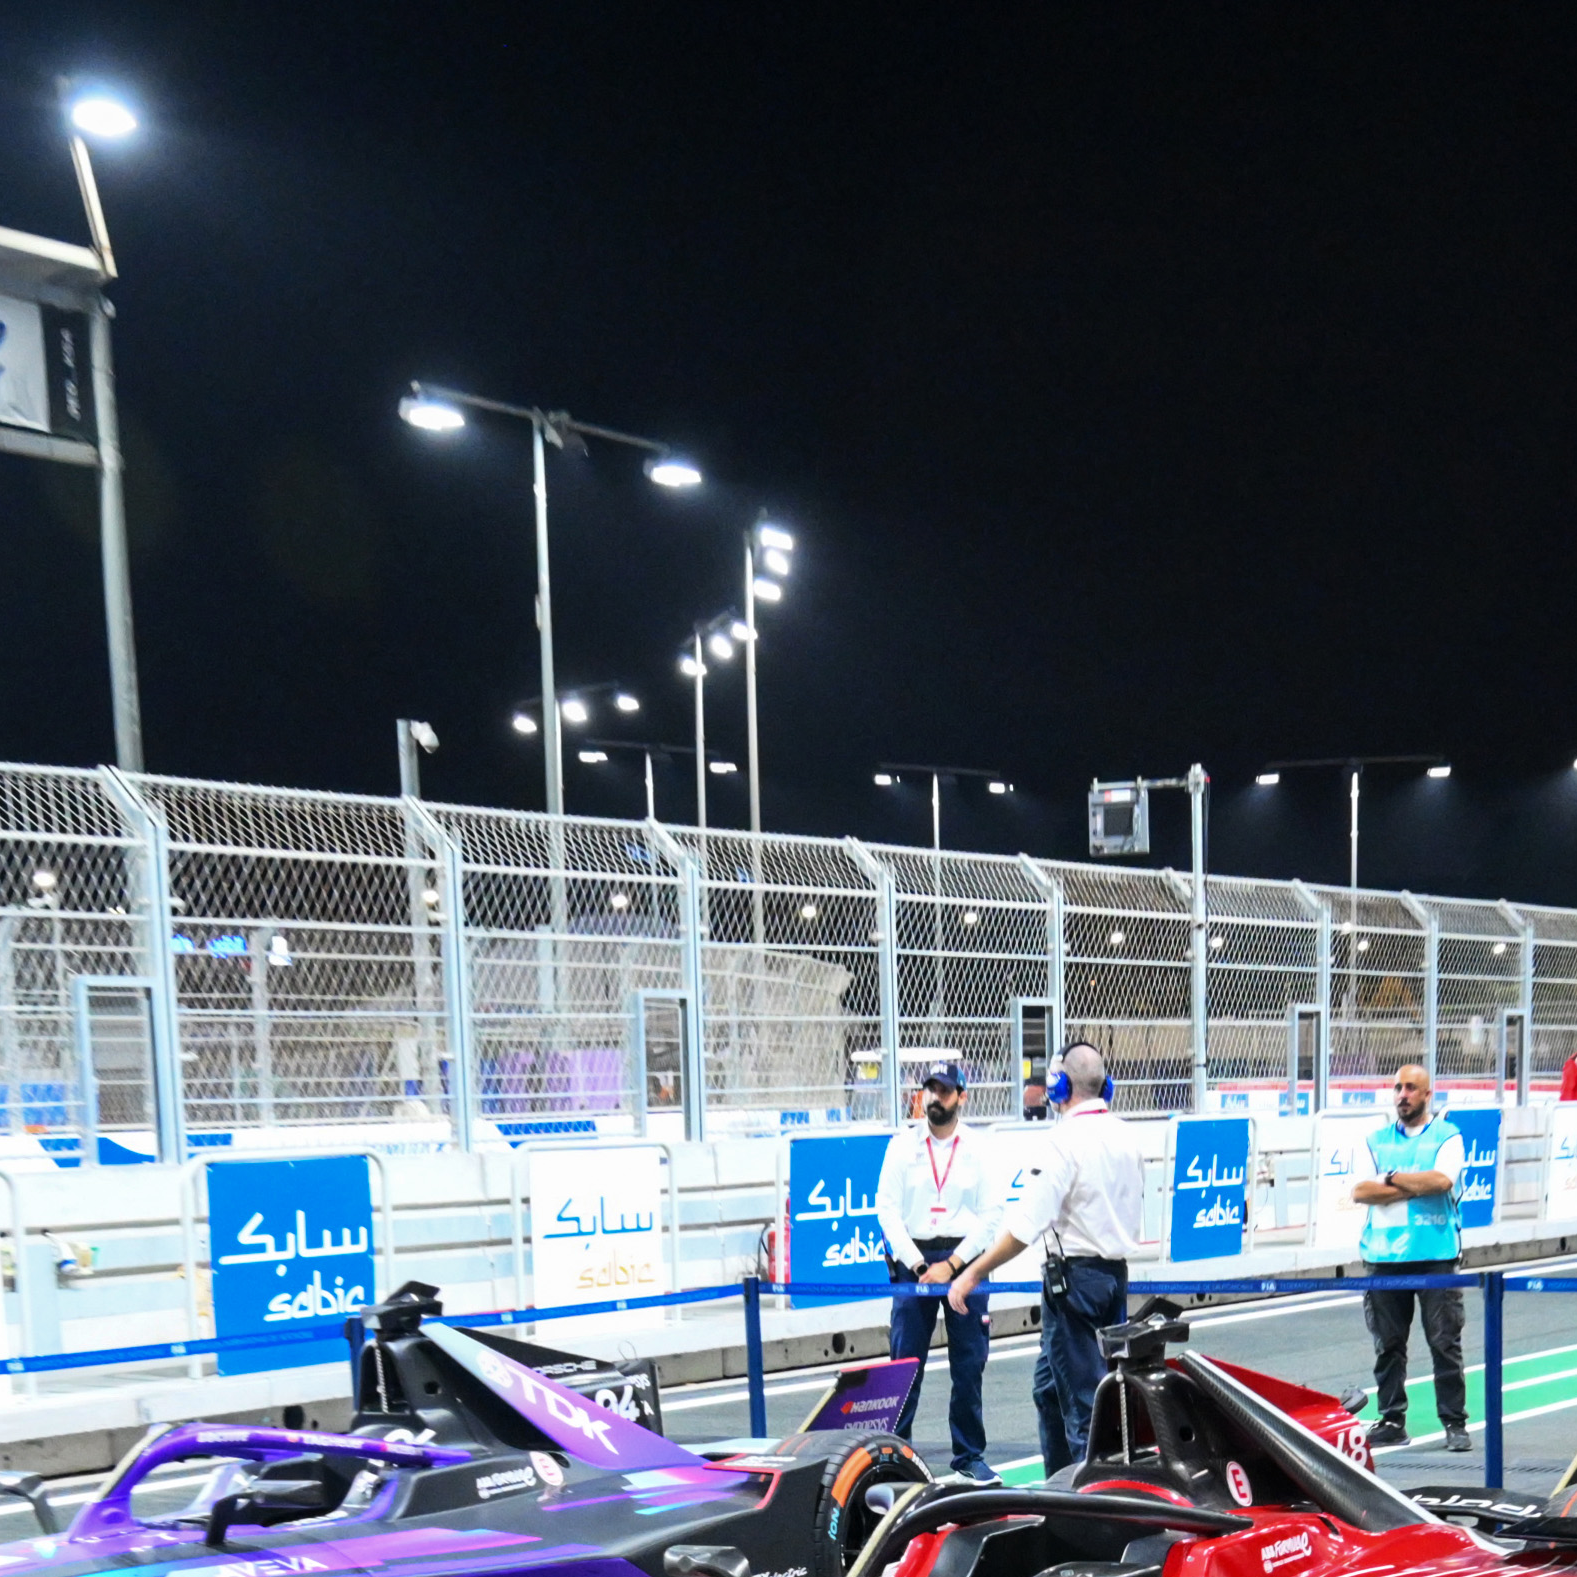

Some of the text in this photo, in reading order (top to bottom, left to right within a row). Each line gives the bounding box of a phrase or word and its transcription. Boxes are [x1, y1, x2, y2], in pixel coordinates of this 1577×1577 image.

[1177, 1154, 1245, 1200] سابك
[542, 1195, 654, 1251] سابك
[1192, 1195, 1242, 1229] sabic
[217, 1208, 369, 1277] سابك
[576, 1247, 656, 1290] sabic
[262, 1269, 368, 1323] sabic
[504, 1362, 620, 1456] TDK
